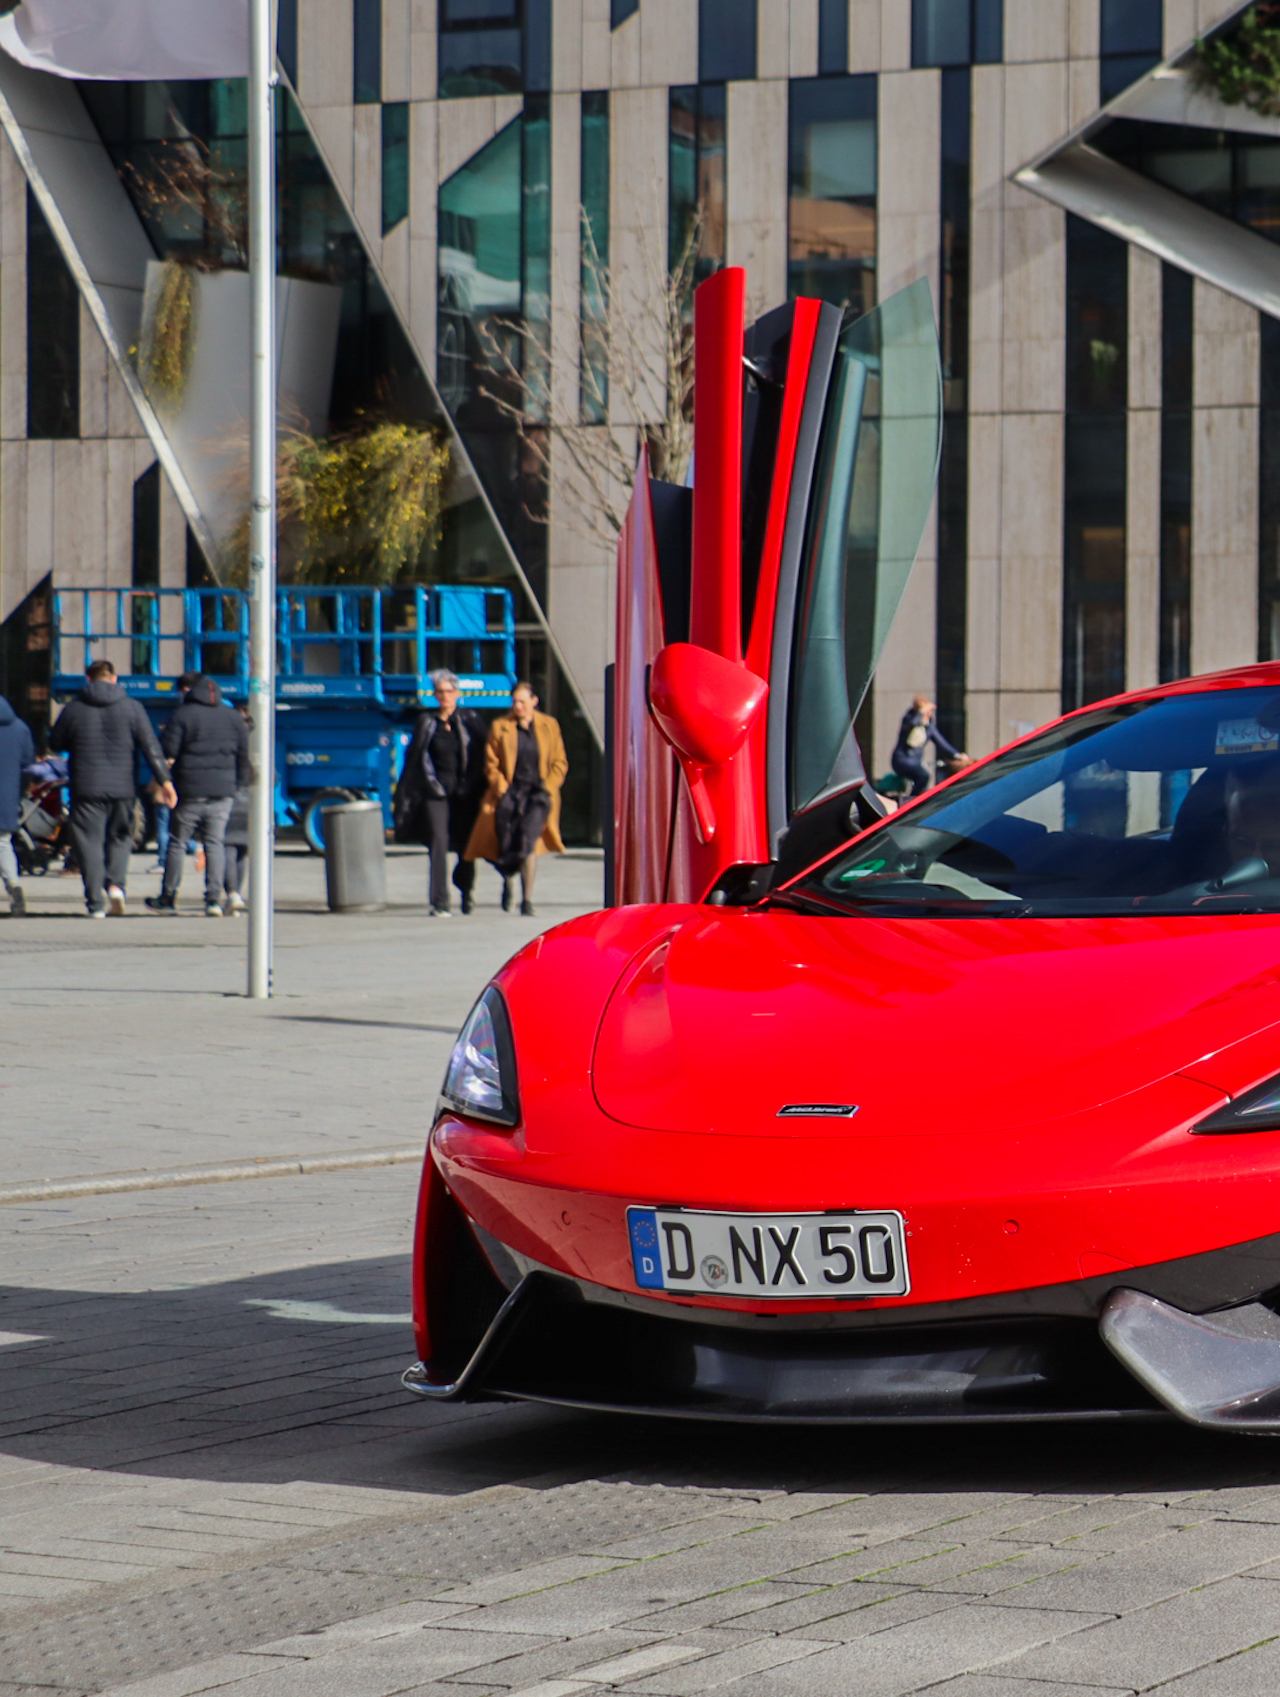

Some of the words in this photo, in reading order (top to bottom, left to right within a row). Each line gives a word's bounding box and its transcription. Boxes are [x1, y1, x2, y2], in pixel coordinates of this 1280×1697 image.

[642, 1257, 655, 1274] D
[661, 1221, 695, 1280] D
[729, 1225, 808, 1285] NX
[818, 1224, 897, 1284] 50
